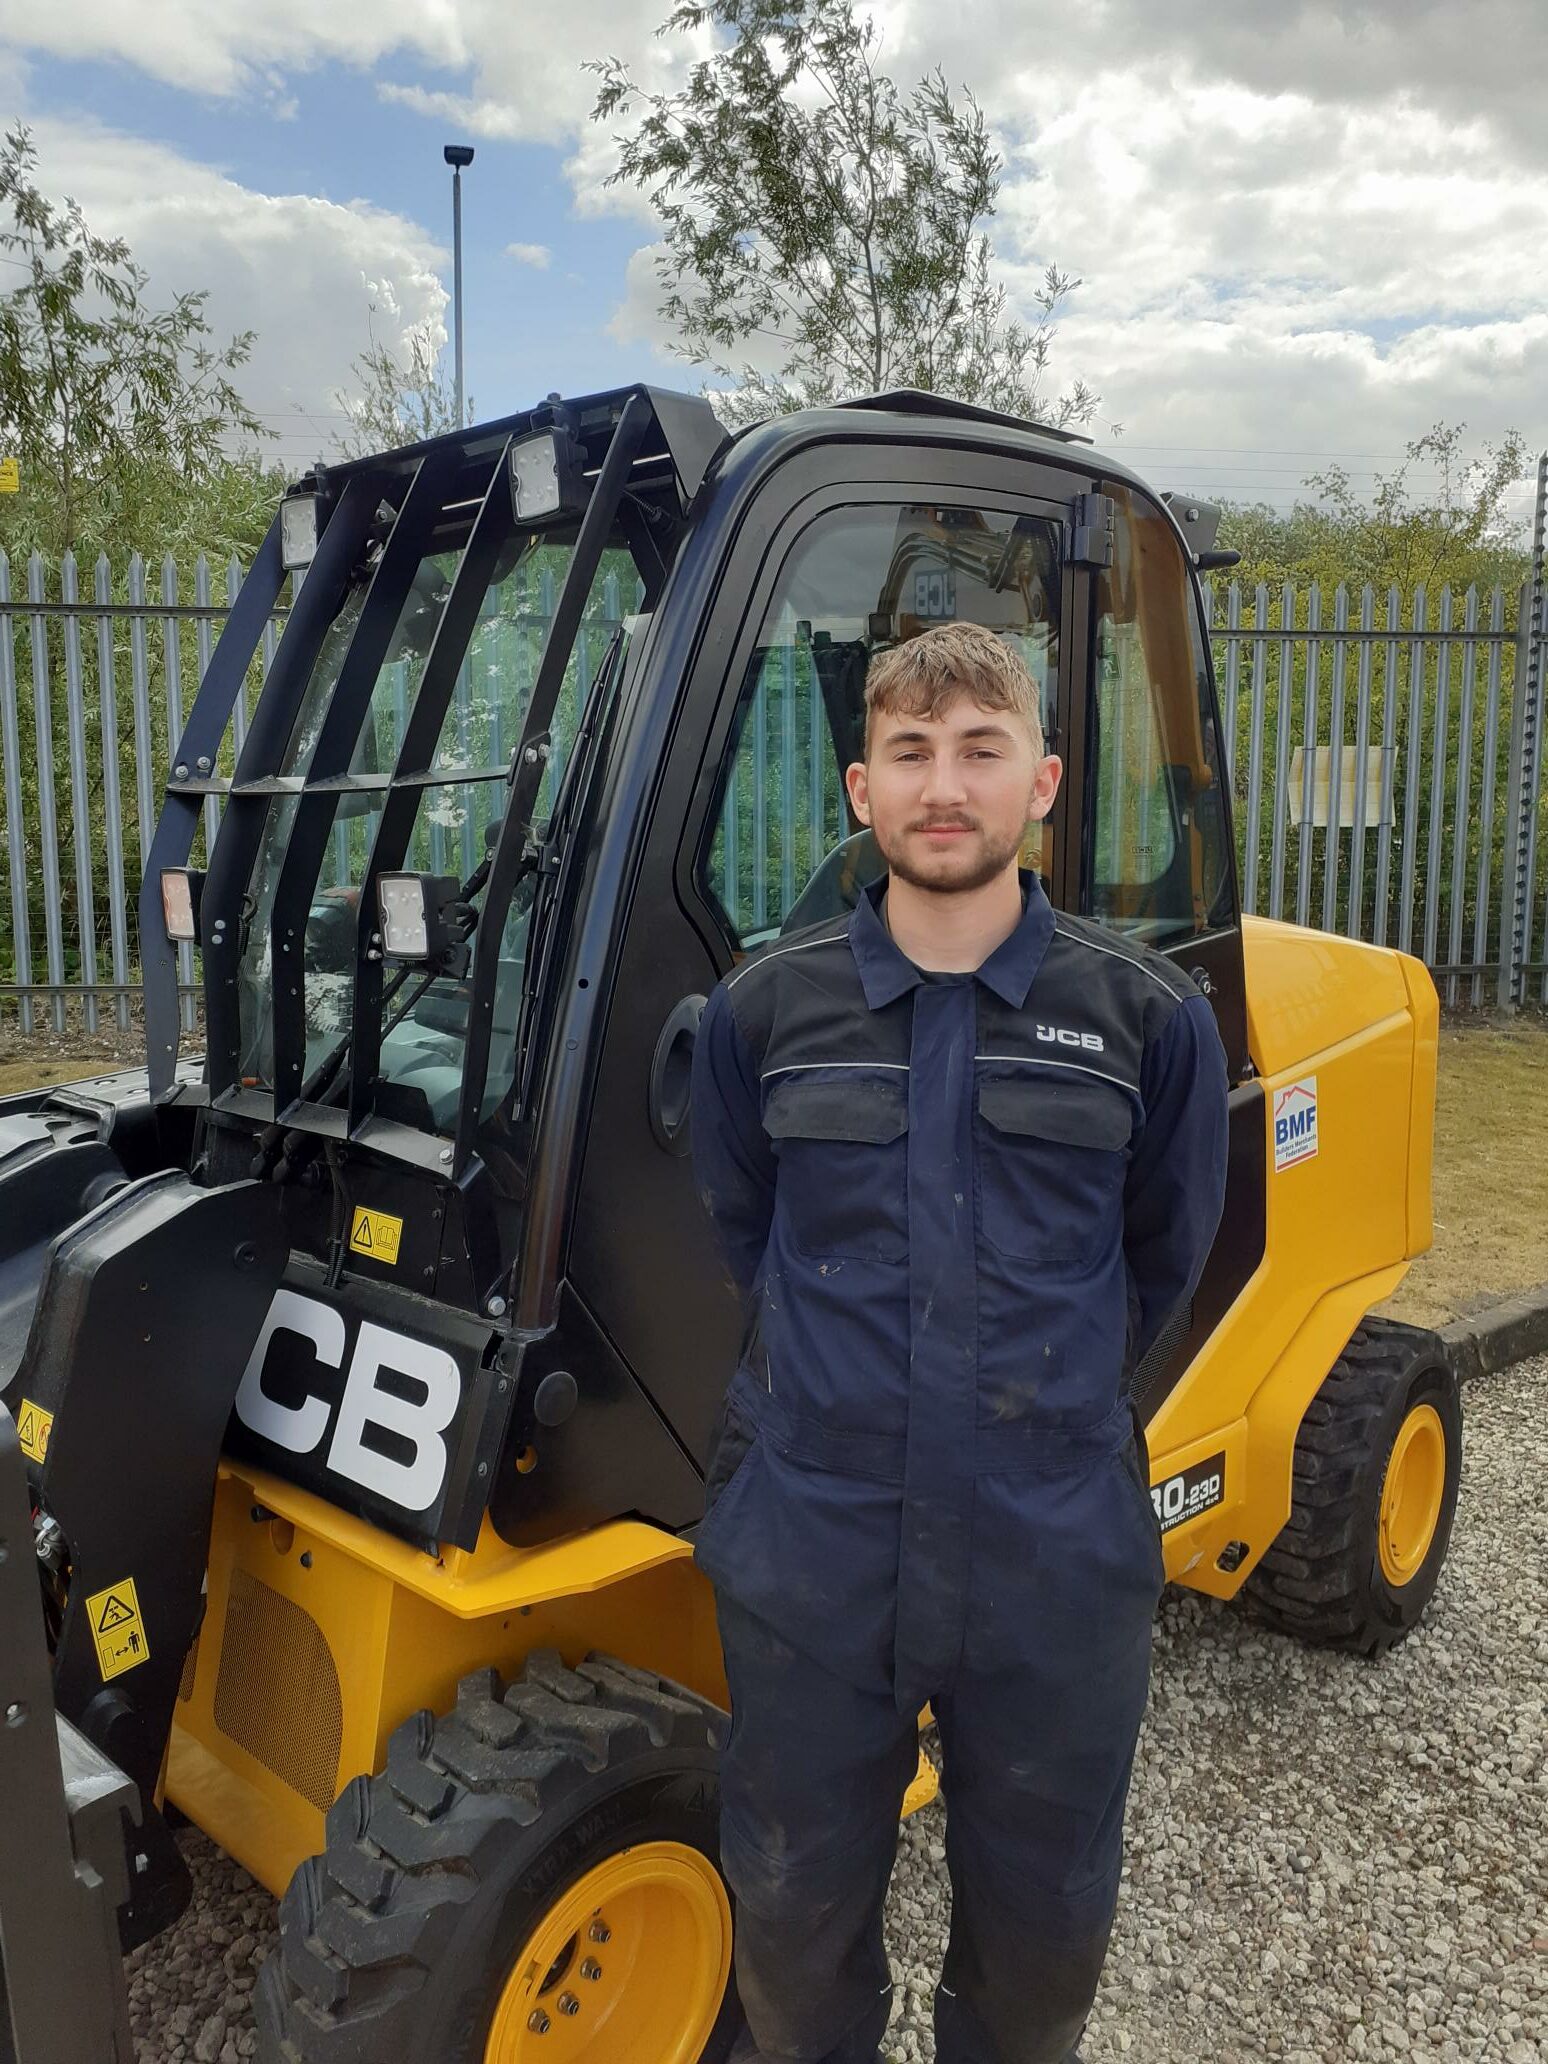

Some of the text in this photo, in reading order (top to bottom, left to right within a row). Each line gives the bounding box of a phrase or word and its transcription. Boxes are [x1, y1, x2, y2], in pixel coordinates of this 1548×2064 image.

[1036, 1024, 1104, 1052] JCB
[1275, 1105, 1316, 1146] BMF
[235, 1289, 461, 1511] CB
